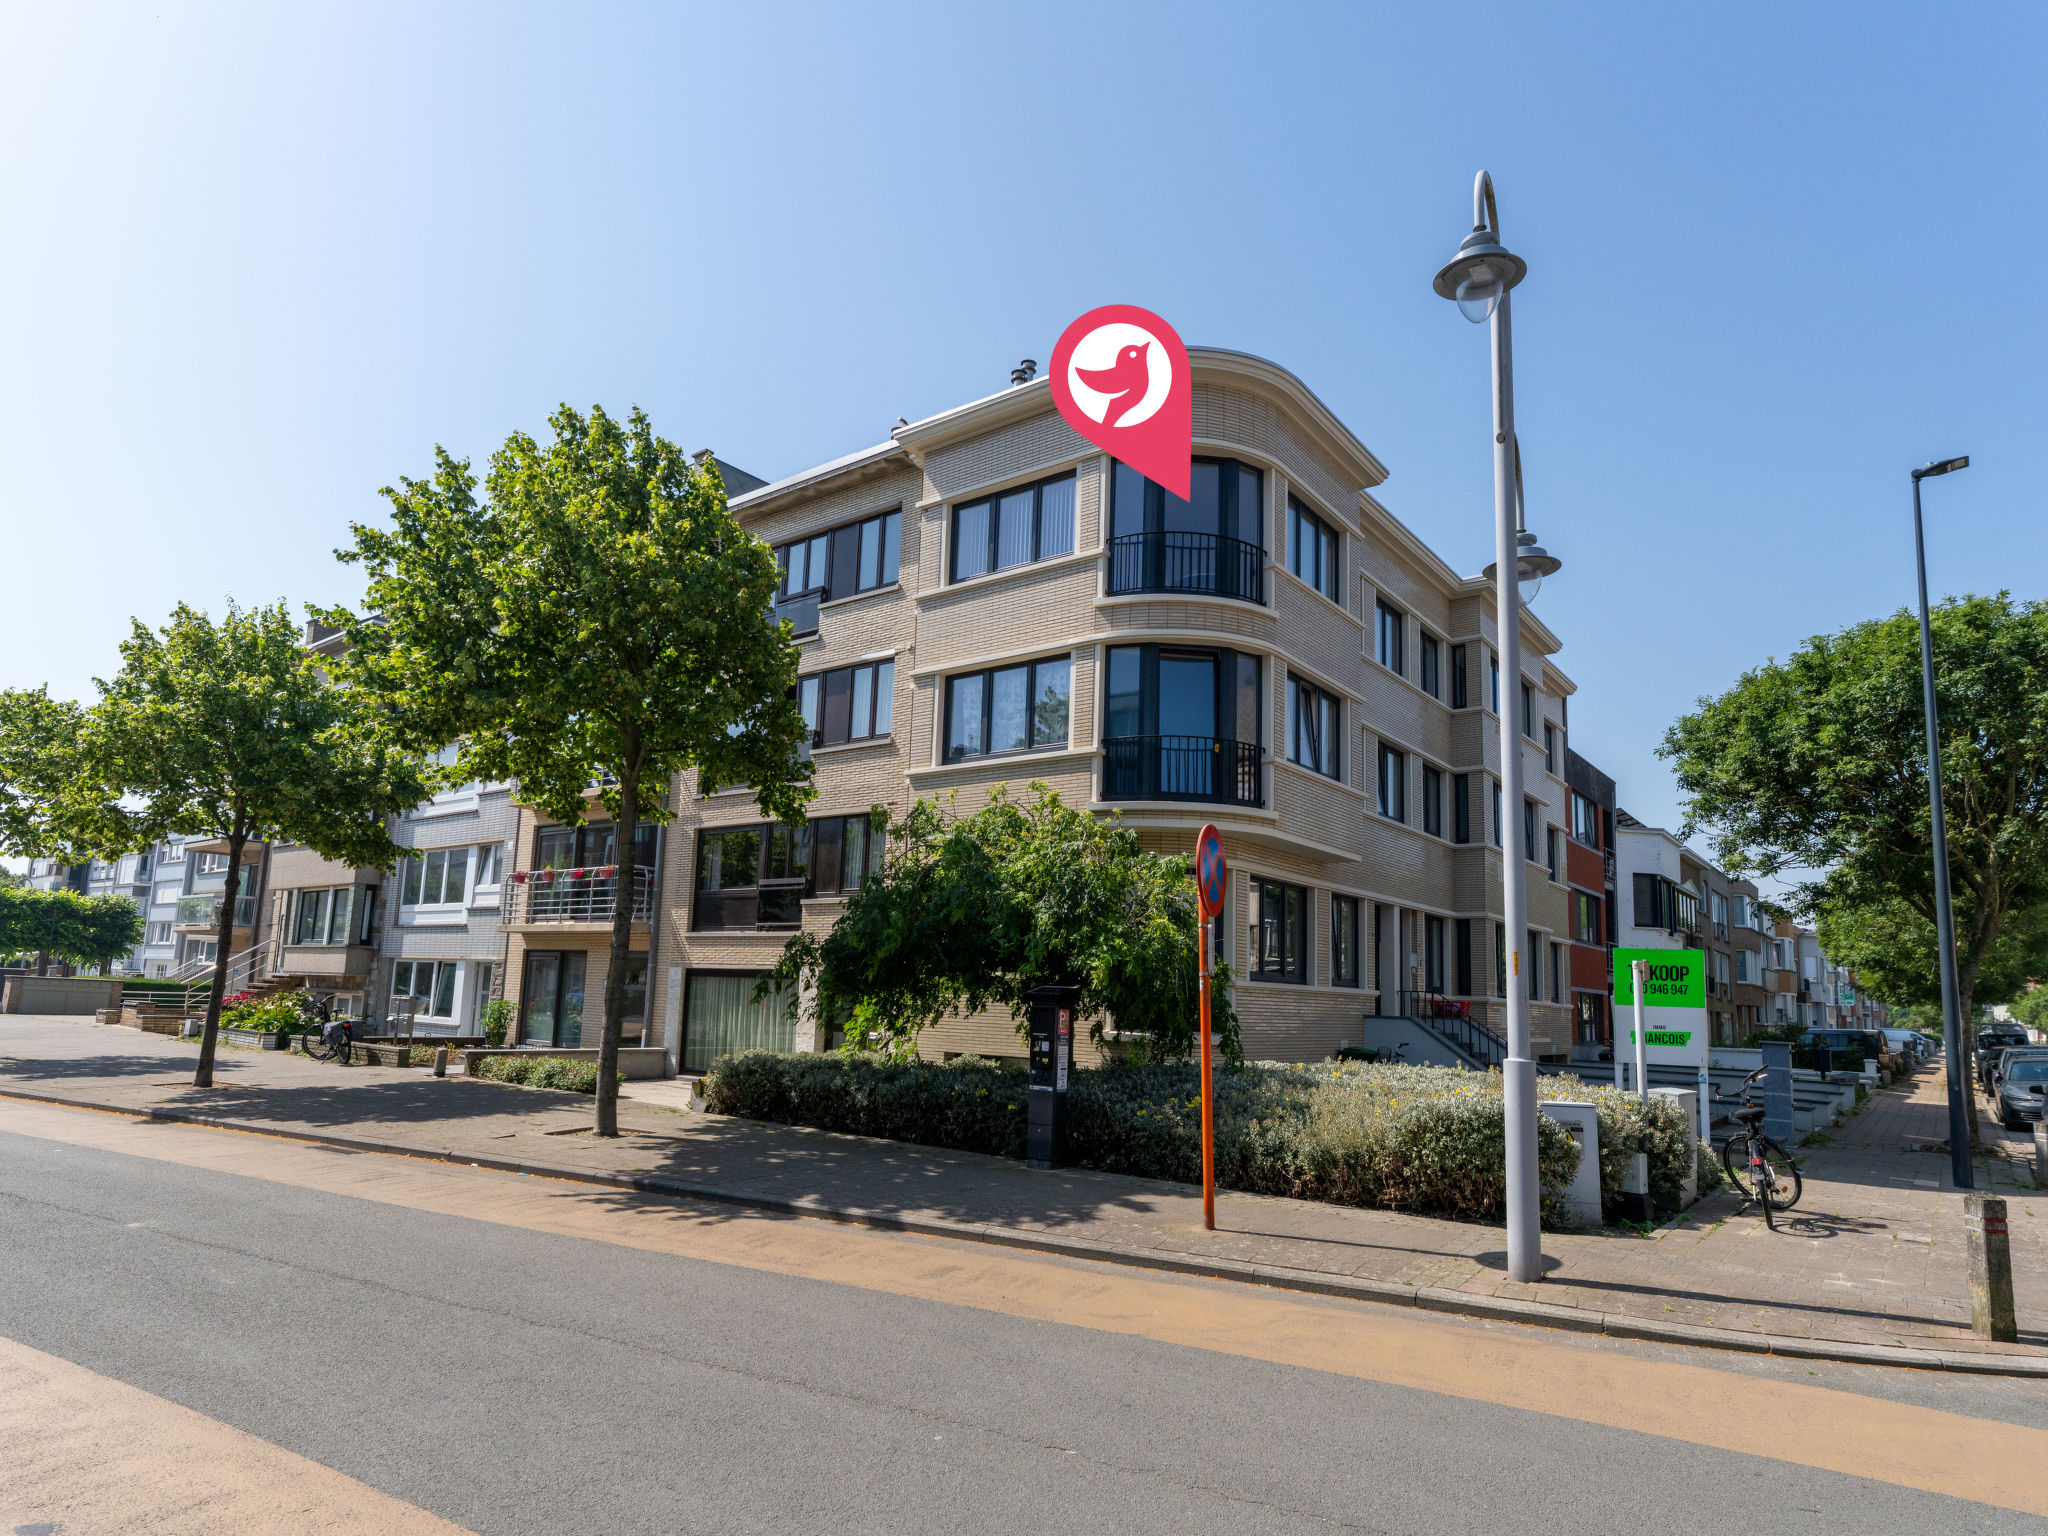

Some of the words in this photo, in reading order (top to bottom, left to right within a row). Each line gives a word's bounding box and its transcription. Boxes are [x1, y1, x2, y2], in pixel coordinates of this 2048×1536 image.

[1650, 965, 1689, 981] KOOP
[1630, 983, 1647, 994] 00
[1650, 984, 1669, 994] 946
[1671, 985, 1688, 995] 947
